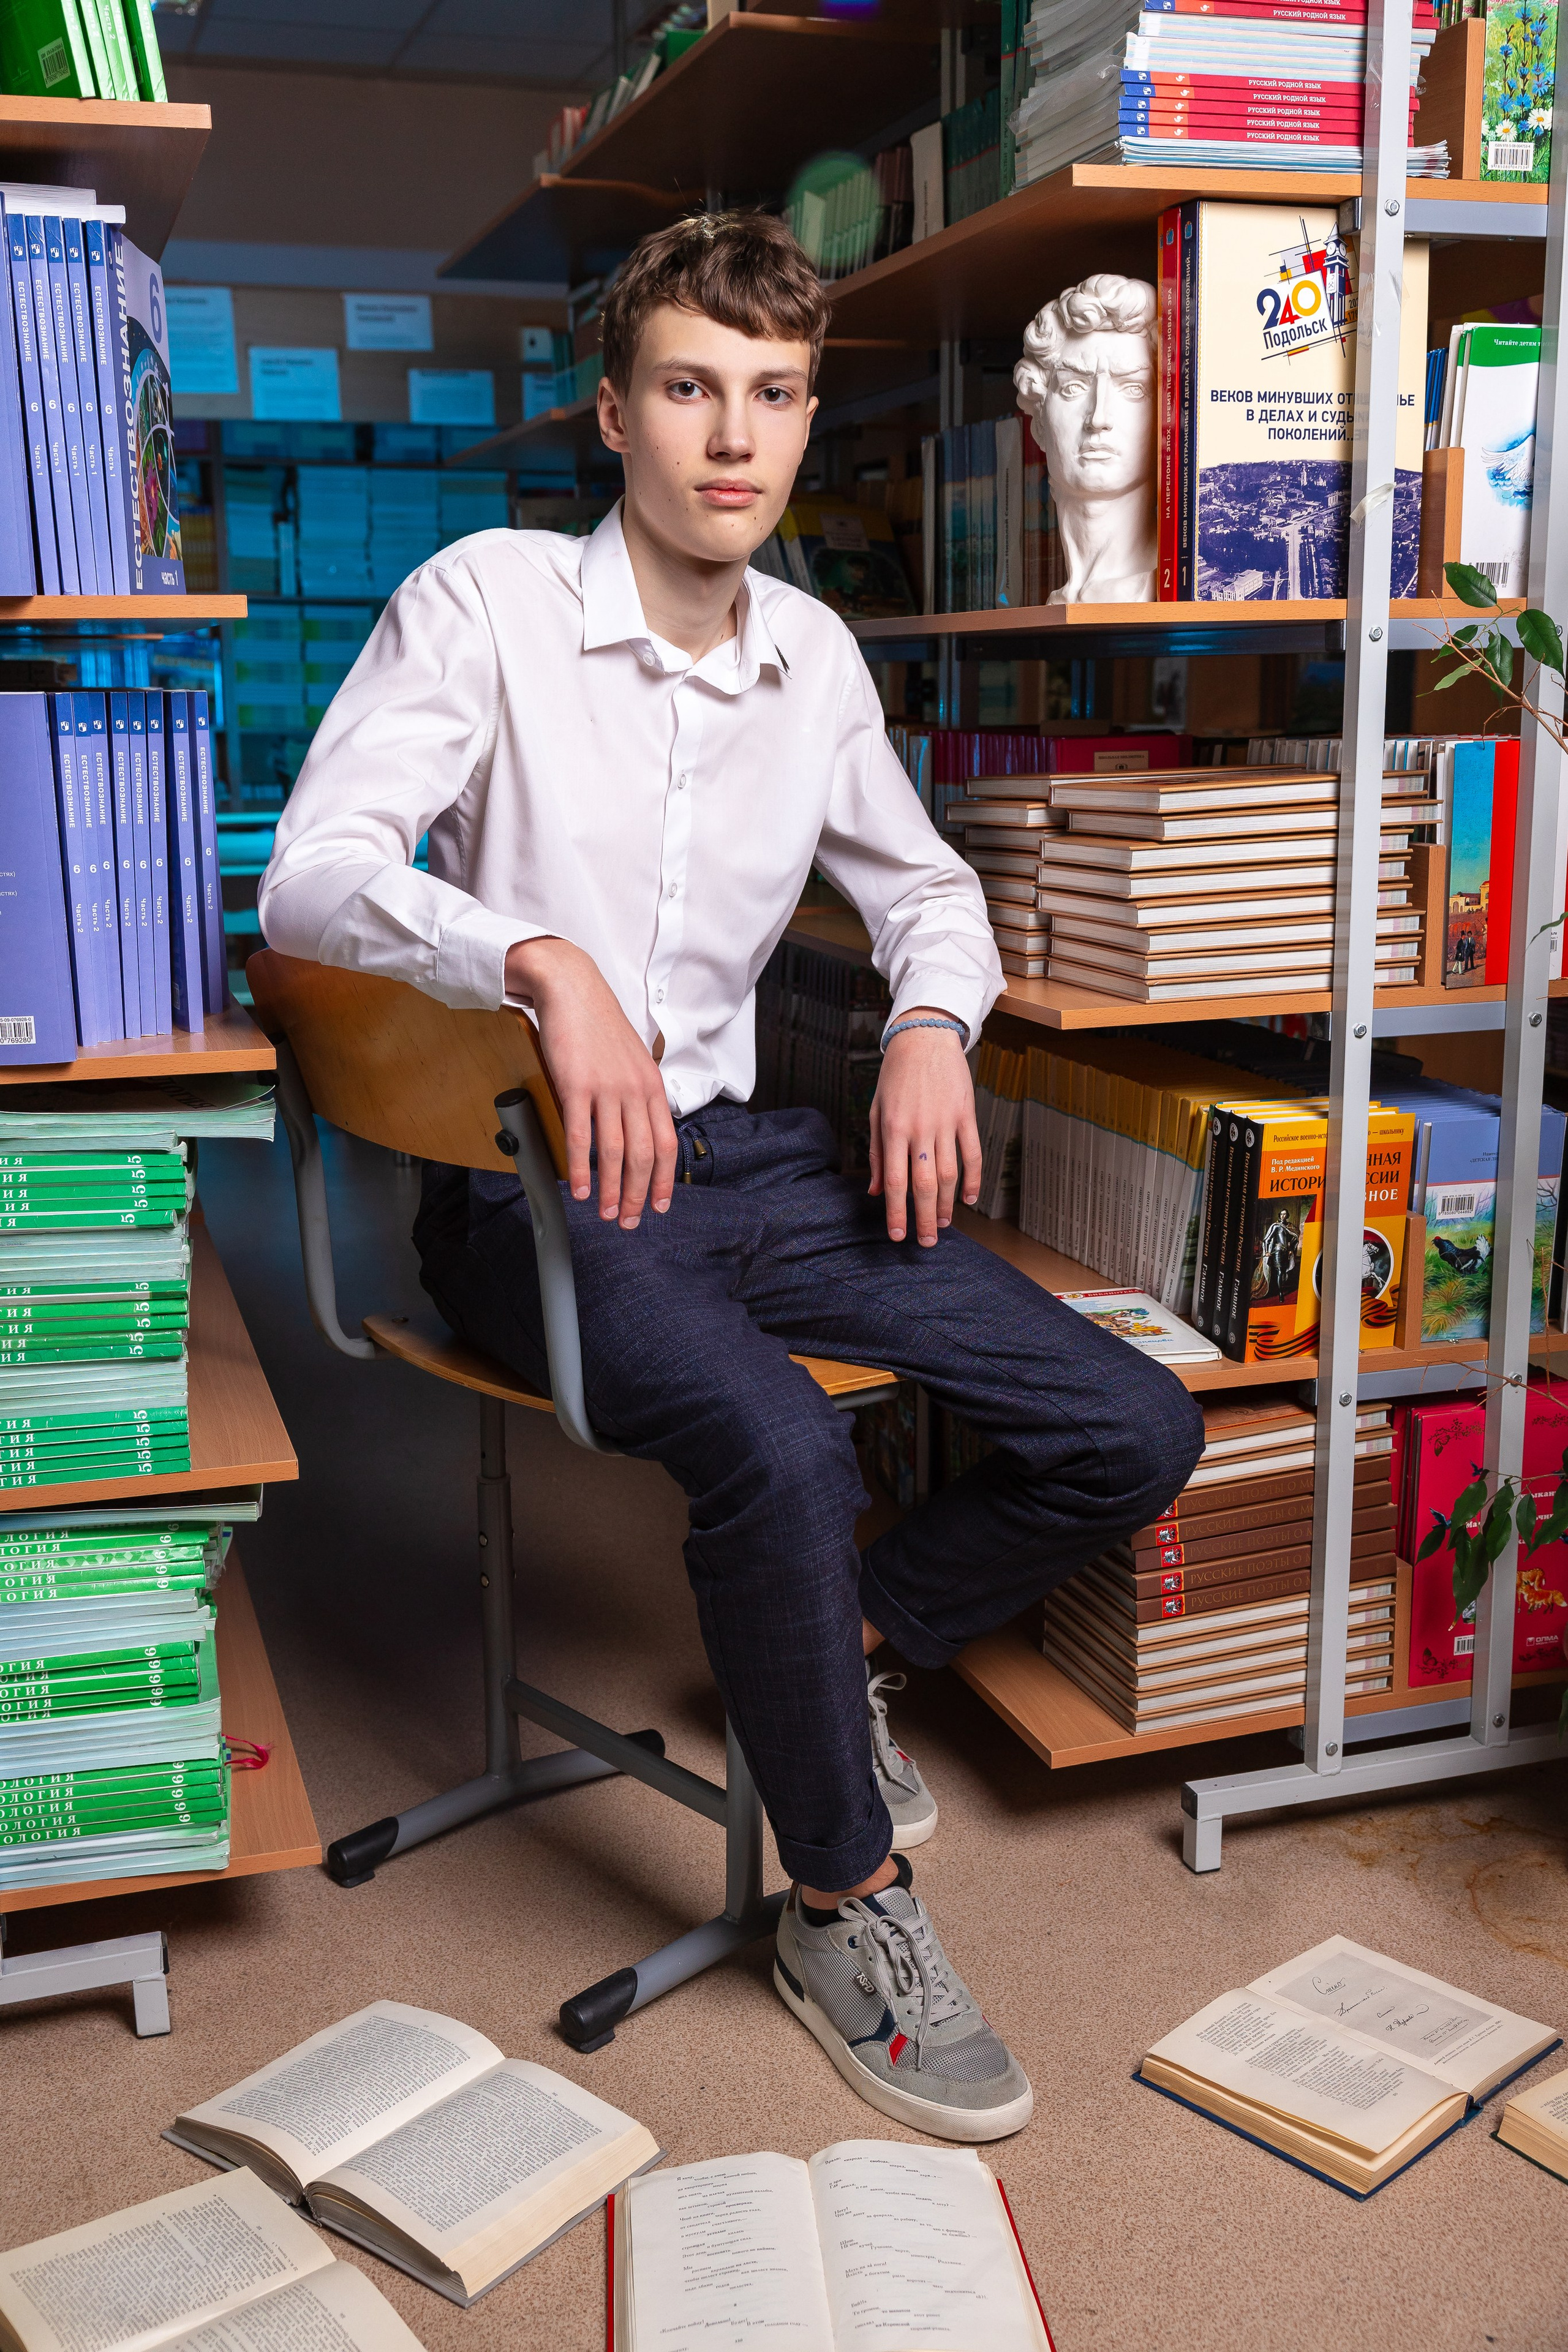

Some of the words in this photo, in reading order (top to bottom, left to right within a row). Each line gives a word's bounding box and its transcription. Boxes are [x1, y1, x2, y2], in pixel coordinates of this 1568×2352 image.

[150, 273, 162, 344] 6
[1257, 280, 1321, 330] 240
[18, 282, 31, 362] ЕСТЕСТВОЗНАНИЕ
[31, 402, 39, 412] 6
[55, 283, 68, 363] ЕСТЕСТВОЗНАНИЕ
[68, 403, 75, 412] 6
[95, 286, 107, 365] ЕСТЕСТВОЗНАНИЕ
[105, 405, 112, 414] 6
[1211, 390, 1253, 402] ВЕКОВ
[1257, 391, 1333, 404] МИНУВШИХ
[113, 241, 143, 590] ЕСТЕСТВОЗНАНИЕ
[1246, 409, 1254, 421] В
[1258, 409, 1303, 423] ДЕЛАХ
[1308, 410, 1316, 422] И
[1322, 410, 1354, 425] СУДЬ
[1166, 506, 1170, 519] НА
[175, 569, 179, 587] 1
[1164, 568, 1169, 588] 2
[1182, 566, 1186, 586] 1
[64, 754, 75, 827] ЕСТЕСТВОЗНАНИЕ
[74, 865, 81, 873] 6
[96, 752, 106, 824] ЕСТЕСТВОЗНАНИЕ
[103, 861, 110, 870] 6
[178, 751, 187, 822] ЕСТЕСТВОЗНАНИЕ
[184, 858, 191, 866] 6
[140, 860, 147, 869] 6
[1273, 1134, 1299, 1143] Российское
[1300, 1133, 1327, 1141] военно-исто
[127, 1155, 141, 1164] 5
[1284, 1156, 1314, 1165] редакцией
[132, 1169, 146, 1178] 5
[1270, 1176, 1325, 1192] ИСТОРИ
[1171, 1234, 1181, 1273] ВОЛШЕБНОЕ
[134, 1410, 147, 1419] 5
[138, 1463, 152, 1472] 5
[1185, 1517, 1238, 1536] РУССКИЕ
[1242, 1509, 1284, 1525] ПОЭТЫ
[1288, 1507, 1297, 1516] О
[1191, 1566, 1243, 1585] РУССКИЕ
[1248, 1557, 1289, 1572] ПОЭТЫ
[1293, 1555, 1302, 1564] О
